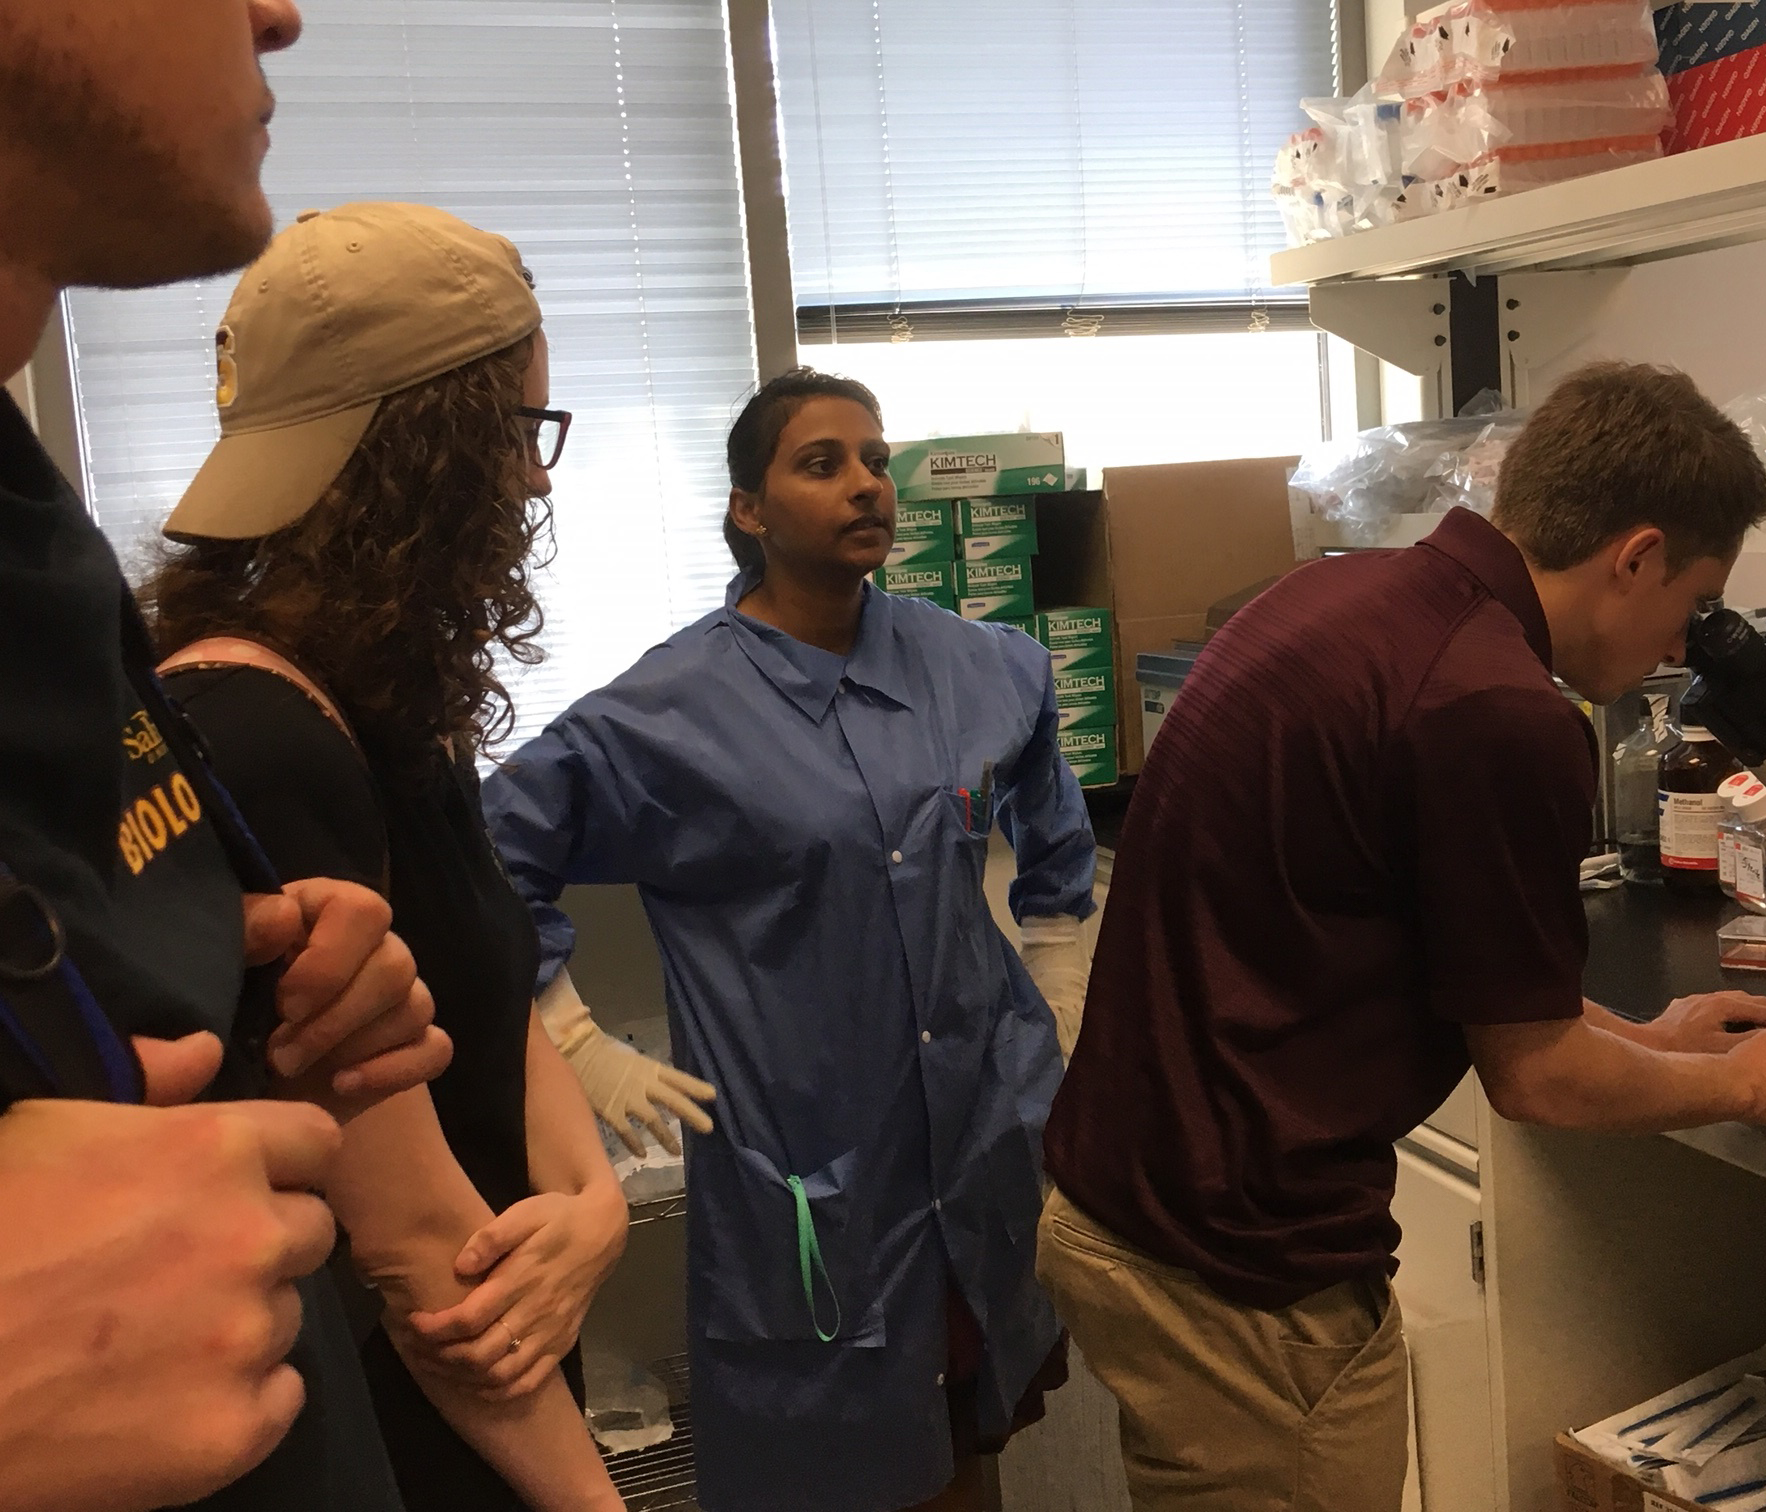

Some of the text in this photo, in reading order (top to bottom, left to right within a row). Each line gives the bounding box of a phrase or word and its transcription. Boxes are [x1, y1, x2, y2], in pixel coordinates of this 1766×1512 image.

[1698, 9, 1718, 34] QIAGEN
[1741, 17, 1760, 41] QIAGEN
[1715, 29, 1734, 53] QIAGEN
[1689, 41, 1709, 65] QIAGEN
[1743, 50, 1761, 80] QIAGEN
[1722, 70, 1738, 99] QIAGEN
[930, 454, 997, 469] KIMTECH
[897, 509, 942, 522] MTECH
[971, 504, 1026, 518] KIMTECH
[886, 571, 942, 584] KIMTECH
[967, 564, 1021, 578] KIMTECH
[1048, 617, 1101, 631] KIMTECH
[1673, 797, 1703, 806] Methanol
